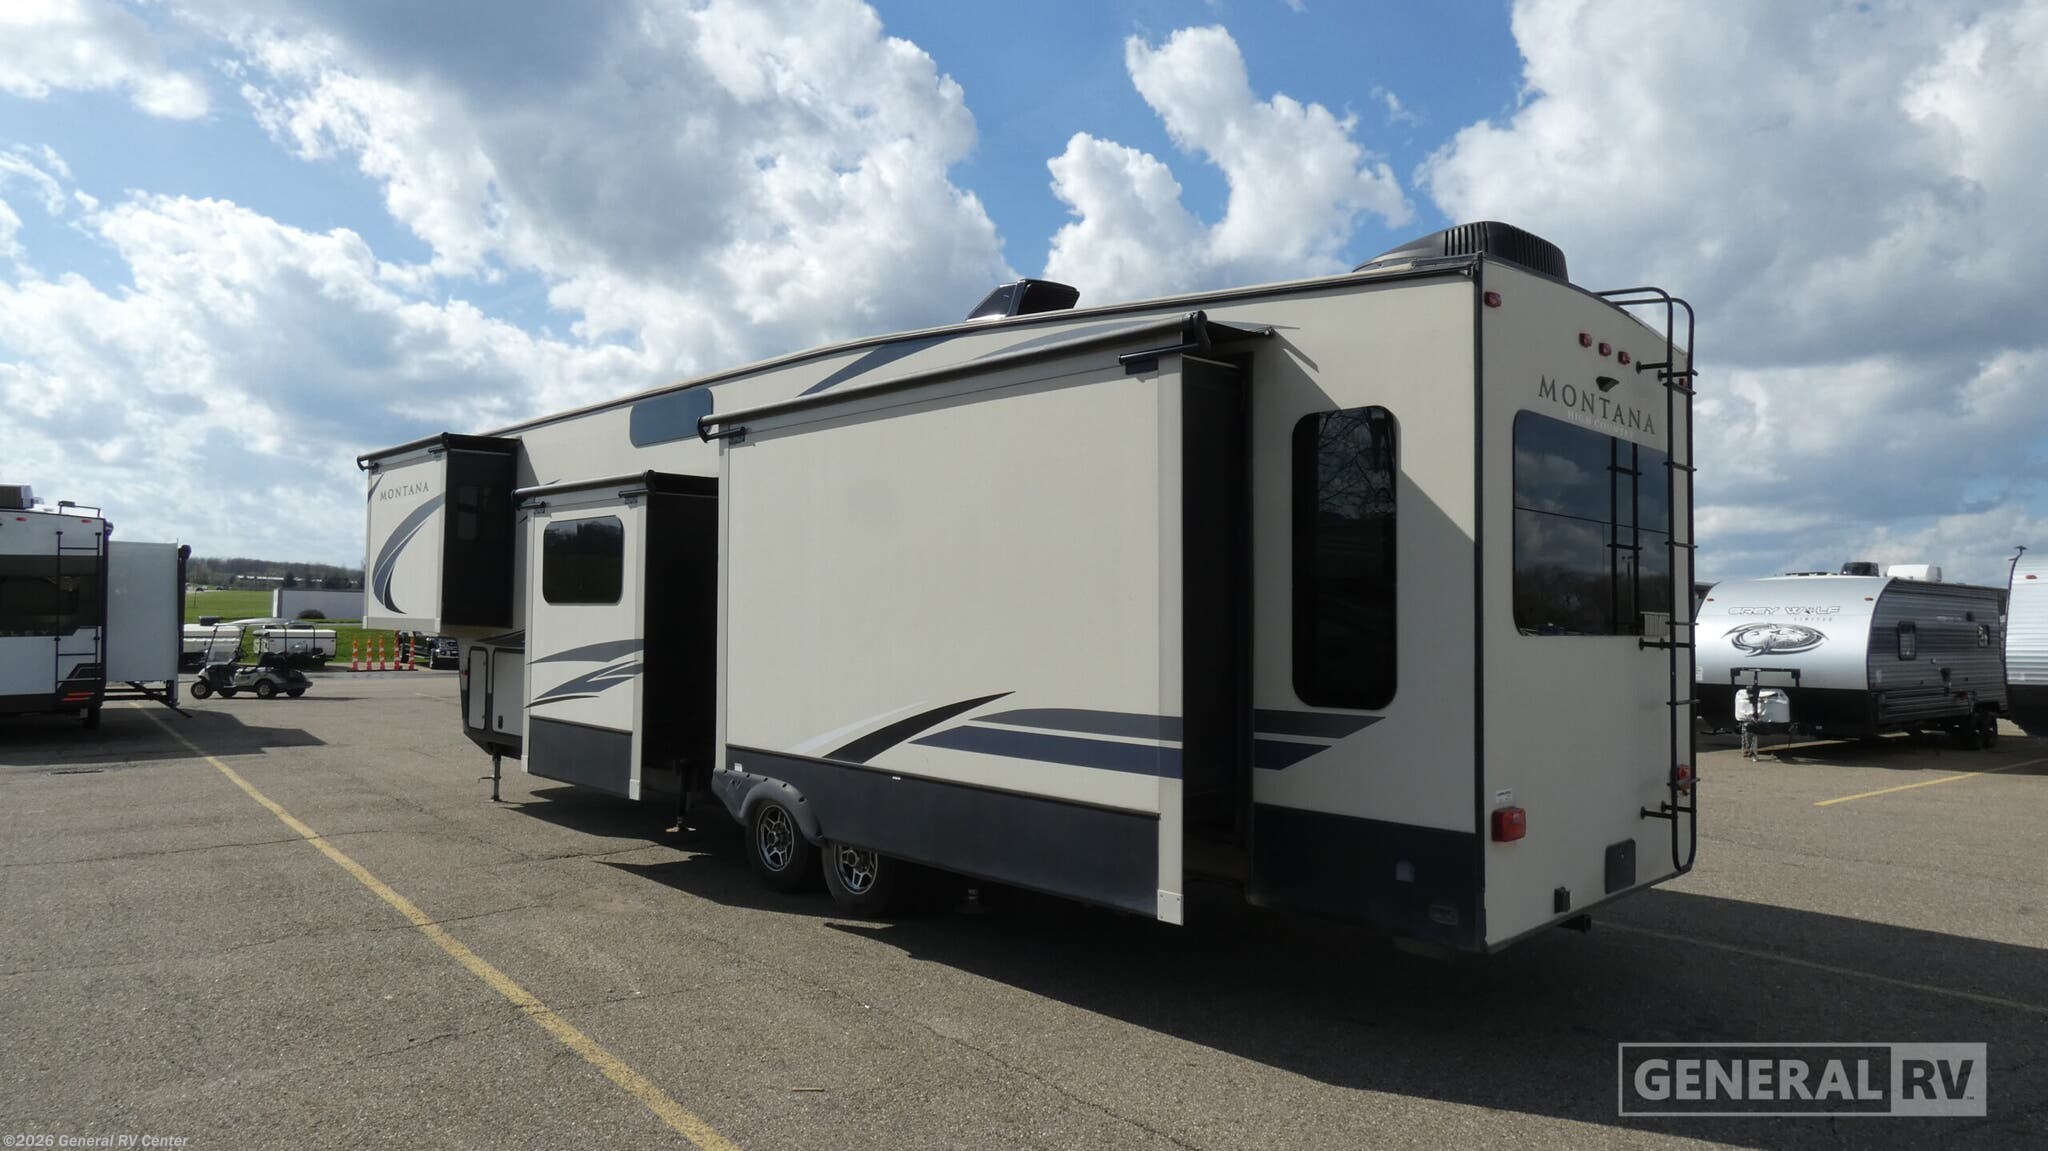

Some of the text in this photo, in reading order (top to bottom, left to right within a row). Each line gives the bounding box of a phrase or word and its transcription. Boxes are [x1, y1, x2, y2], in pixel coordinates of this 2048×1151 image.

[1539, 375, 1655, 434] MONTANA
[380, 482, 430, 501] MONTANA
[1728, 605, 1841, 616] GREY WOLF
